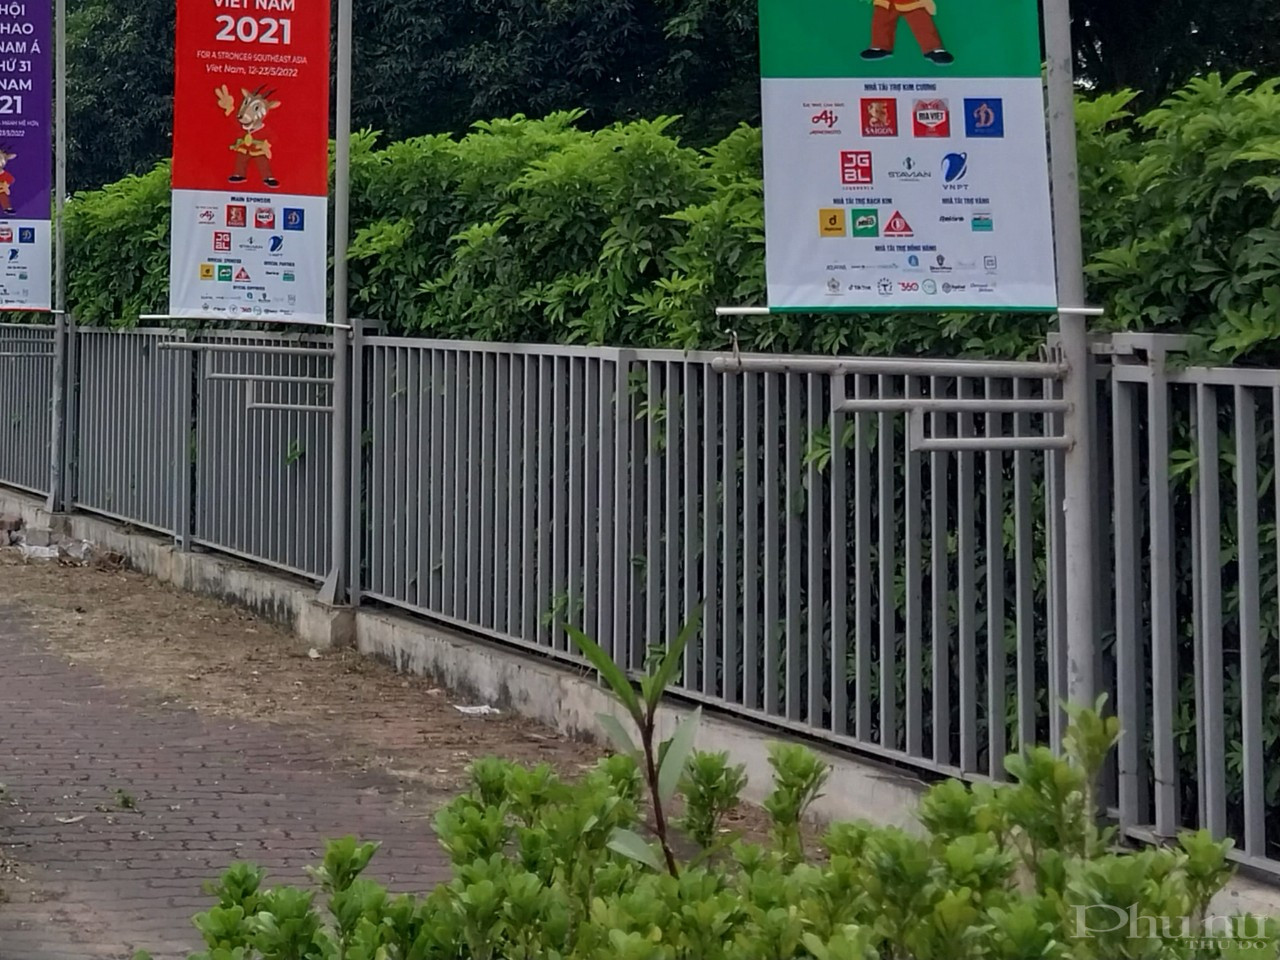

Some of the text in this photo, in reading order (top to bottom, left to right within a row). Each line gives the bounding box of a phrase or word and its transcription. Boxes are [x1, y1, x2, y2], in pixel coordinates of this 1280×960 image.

[215, 15, 291, 45] 2021
[30, 39, 41, 54] Á
[196, 50, 308, 64] FOR A STRONGER SOUTHEAST ASIA
[19, 60, 32, 72] 31
[248, 65, 299, 77] 12-23/5/2022
[864, 82, 878, 91] NHÀ
[903, 83, 915, 91] KIM
